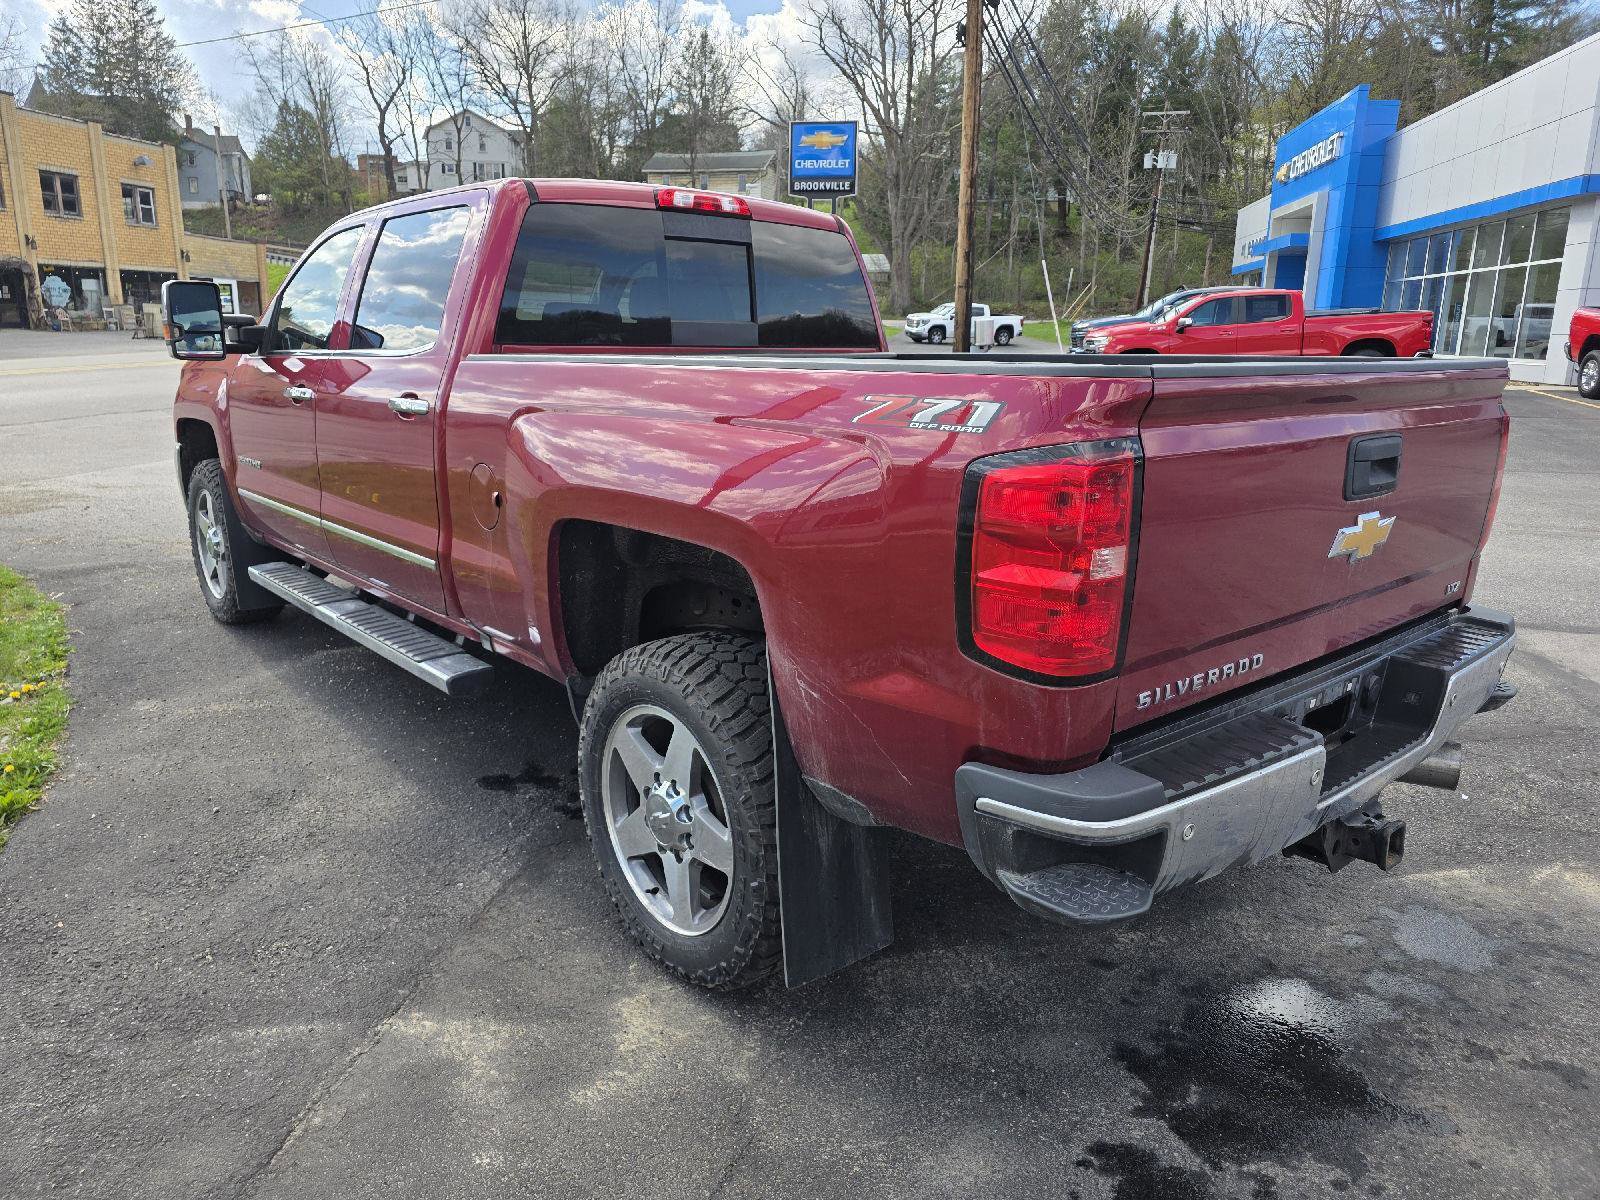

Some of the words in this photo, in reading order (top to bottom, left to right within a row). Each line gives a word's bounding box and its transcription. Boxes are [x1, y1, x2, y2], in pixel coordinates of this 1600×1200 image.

[795, 159, 850, 168] CHEVROLET
[1290, 132, 1344, 178] CHEVROLET
[794, 181, 850, 190] BROOKVILLE
[850, 394, 1007, 428] Z71
[909, 421, 938, 429] OFF
[940, 424, 983, 434] ROAD
[1137, 653, 1264, 710] SILVERADO
